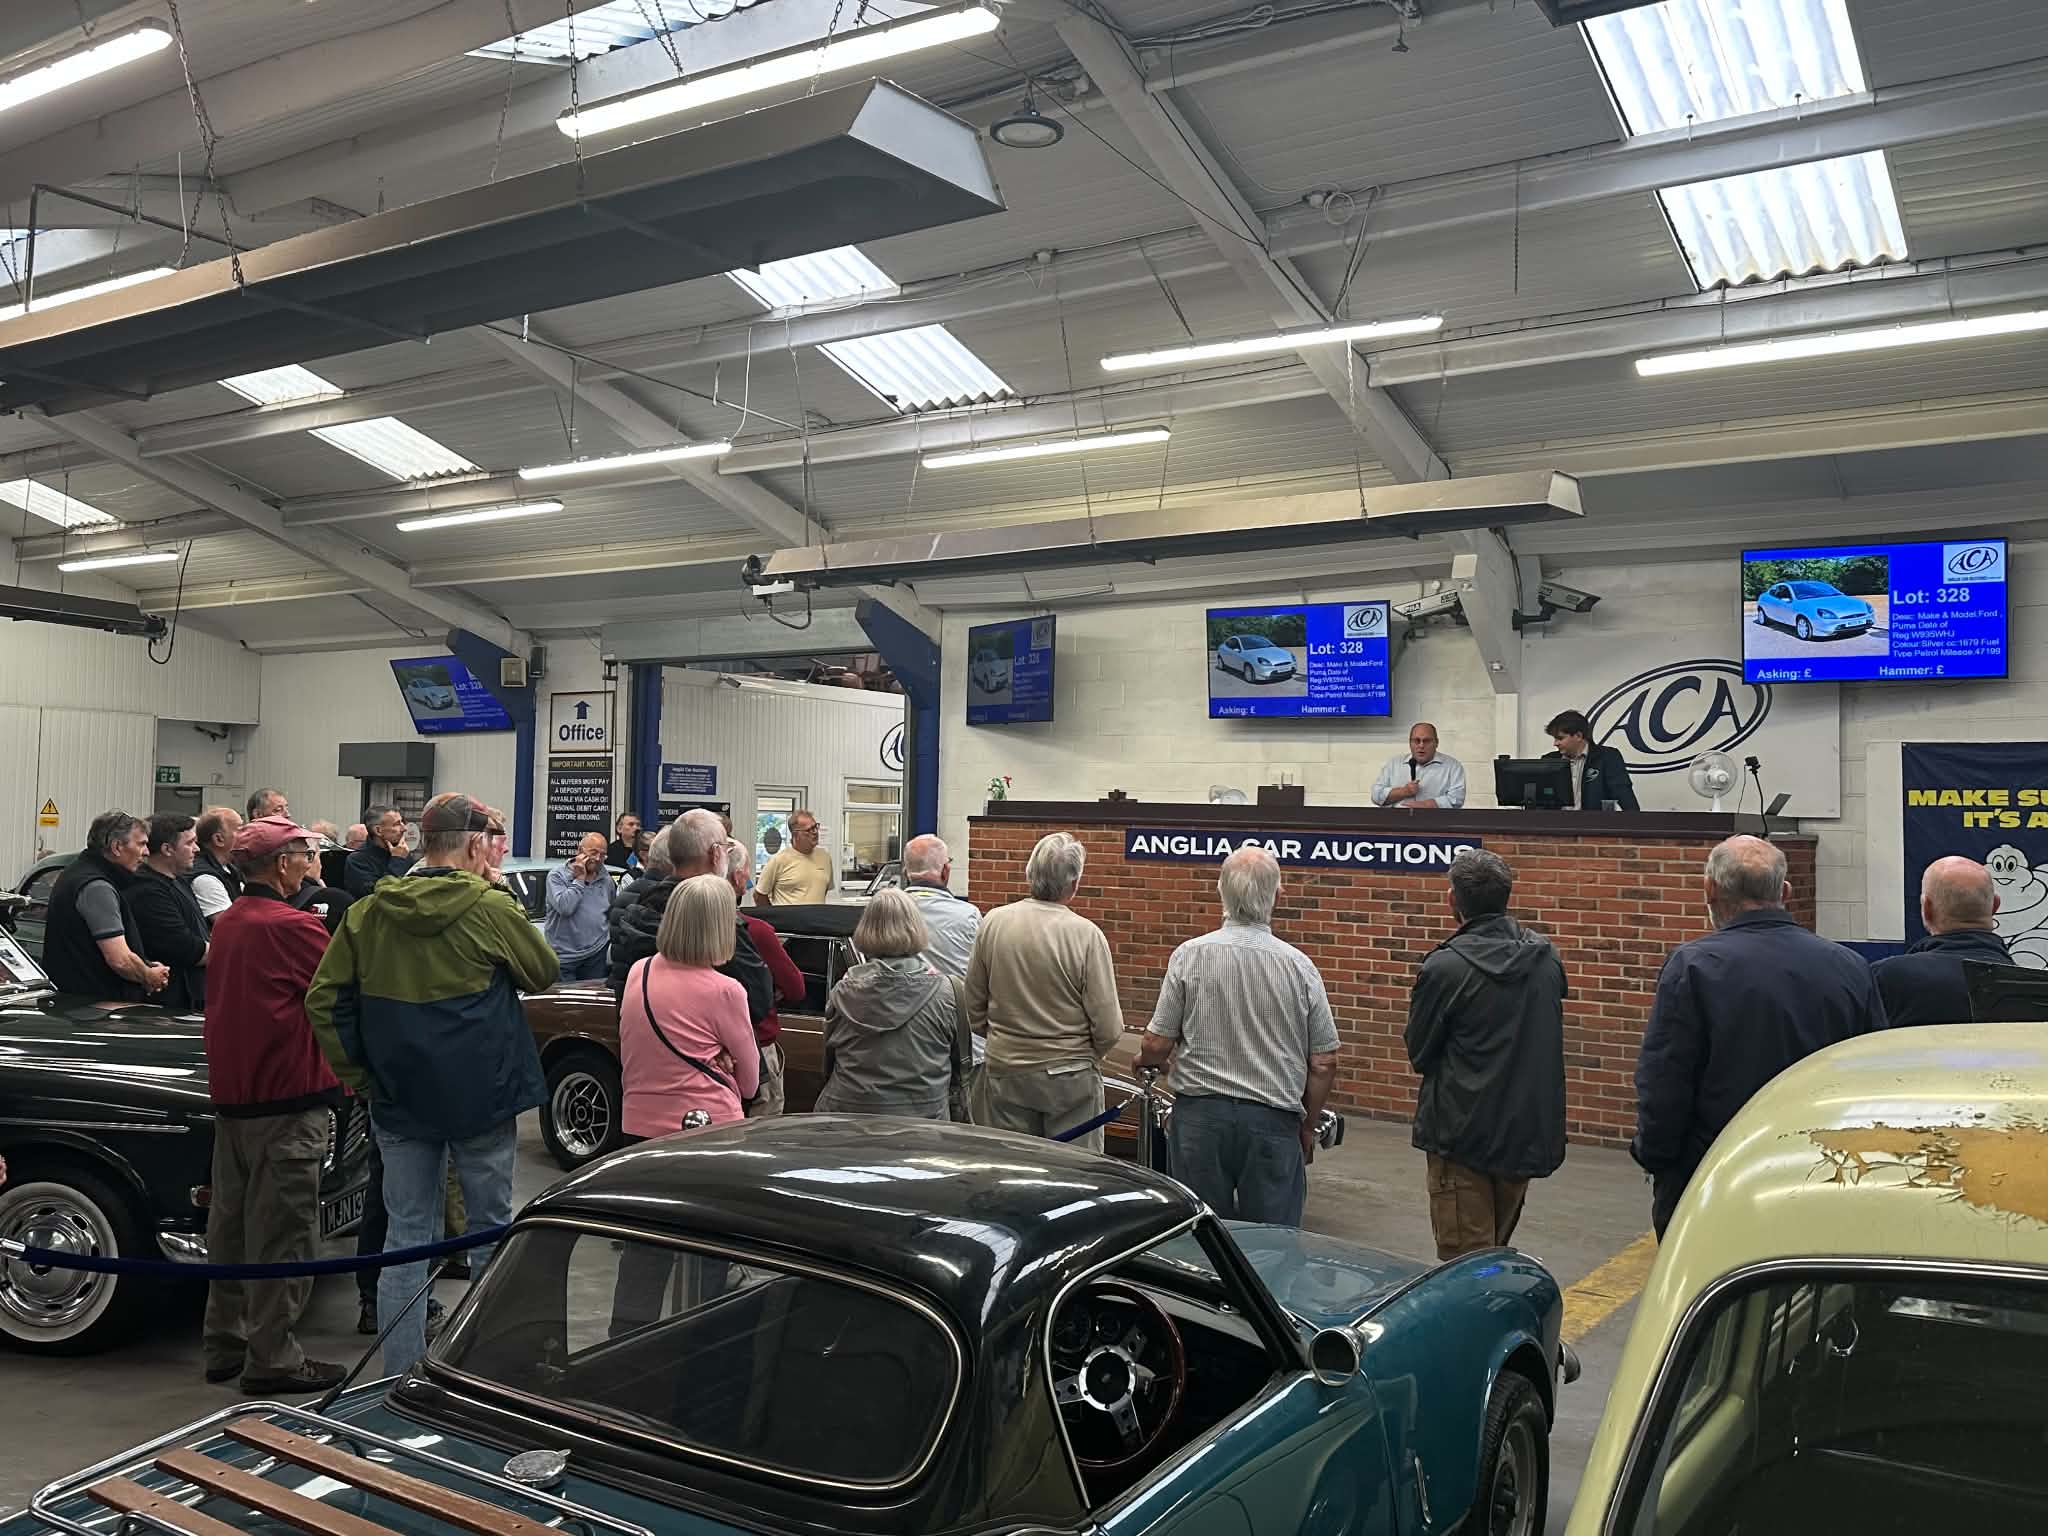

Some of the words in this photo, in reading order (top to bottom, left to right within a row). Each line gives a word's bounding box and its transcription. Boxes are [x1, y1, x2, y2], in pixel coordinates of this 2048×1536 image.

[1949, 548, 1995, 572] ACA
[1893, 589, 1930, 605] Lot:
[1936, 587, 1971, 603] 328
[1348, 608, 1381, 629] ACA
[1918, 611, 1941, 620] Make
[1942, 611, 1949, 619] &
[1892, 621, 1916, 631] Puma
[1918, 620, 1938, 629] Date
[1939, 620, 1949, 629] of
[1309, 642, 1336, 656] Lot:
[1339, 641, 1364, 654] 328
[1981, 637, 2000, 646] Fuel
[1756, 669, 1801, 681] Asking:
[1803, 668, 1813, 678] £
[1879, 665, 1933, 677] Hammer:
[1935, 664, 1945, 675] £
[1218, 705, 1249, 716] Asking:
[1249, 705, 1257, 714] £
[1301, 704, 1340, 714] Hammer:
[1340, 703, 1347, 713] £
[1598, 675, 1743, 755] ACA
[558, 723, 604, 741] Office
[1908, 789, 2009, 806] MAKE
[1963, 808, 2021, 828] IT'S
[1130, 835, 1233, 856] ANGLIA
